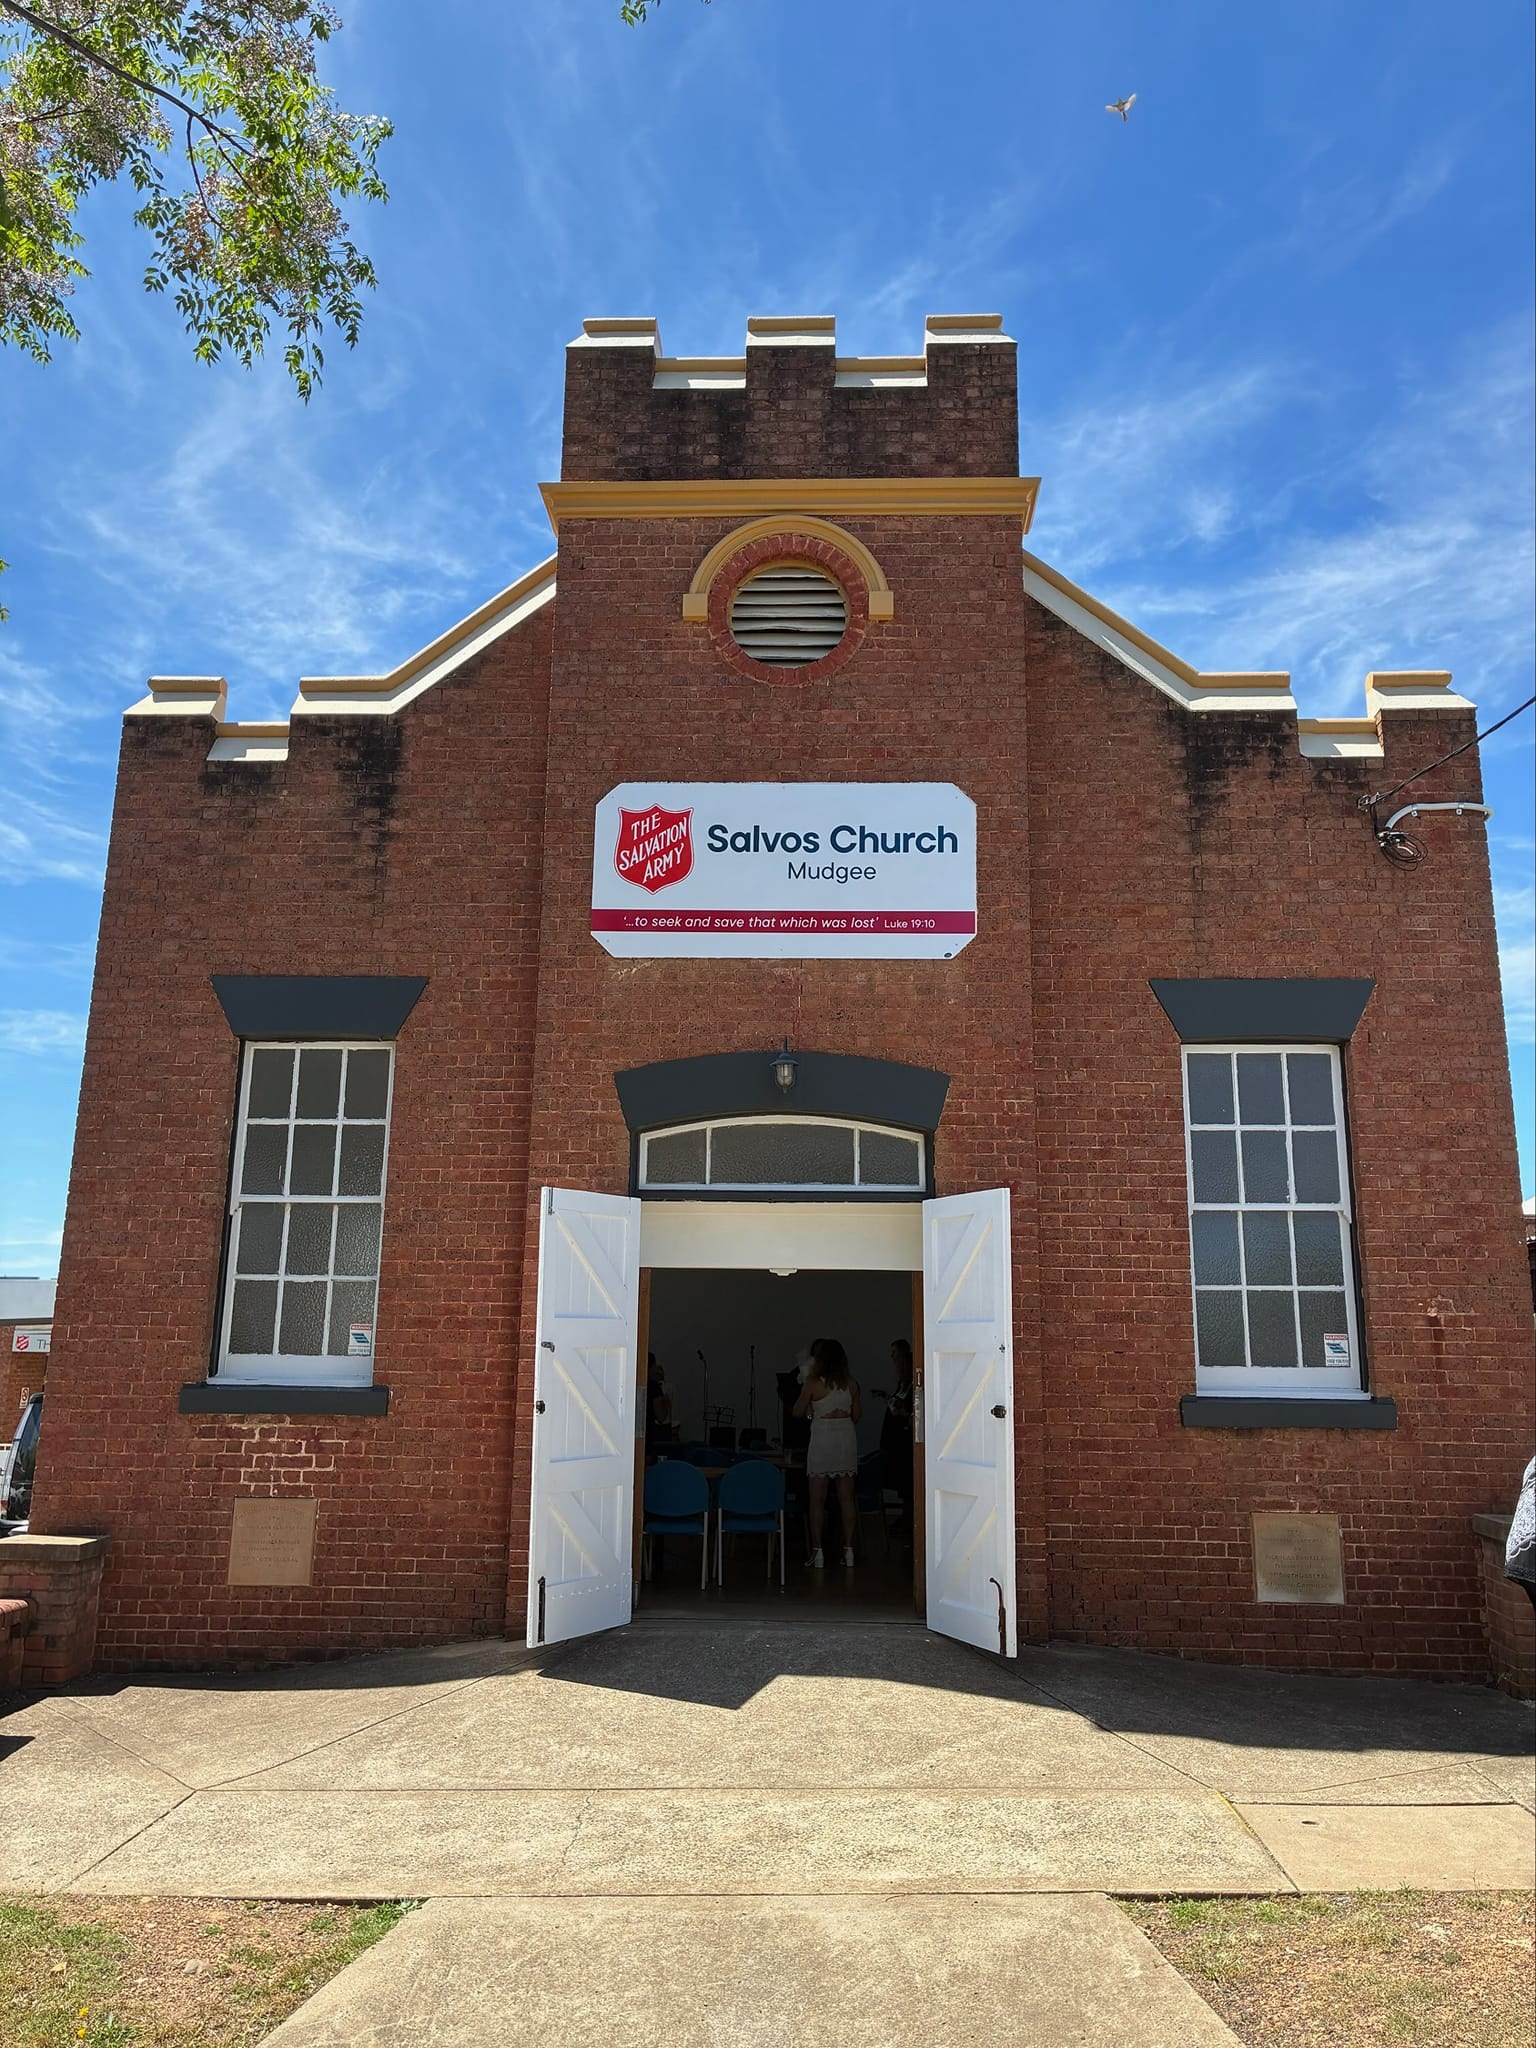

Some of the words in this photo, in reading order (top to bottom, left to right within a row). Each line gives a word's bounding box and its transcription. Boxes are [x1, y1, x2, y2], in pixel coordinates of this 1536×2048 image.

[631, 811, 662, 841] THE
[706, 824, 820, 854] Salvos
[830, 824, 959, 854] Church
[618, 816, 688, 871] SALVATION
[642, 842, 685, 884] ARMY
[787, 861, 877, 884] Mudgee
[651, 915, 682, 928] seek
[684, 916, 711, 928] and
[713, 918, 745, 928] save
[748, 916, 776, 928] that
[779, 916, 818, 929] which
[821, 918, 848, 929] was
[884, 919, 909, 929] Luke
[910, 919, 936, 929] 19:10
